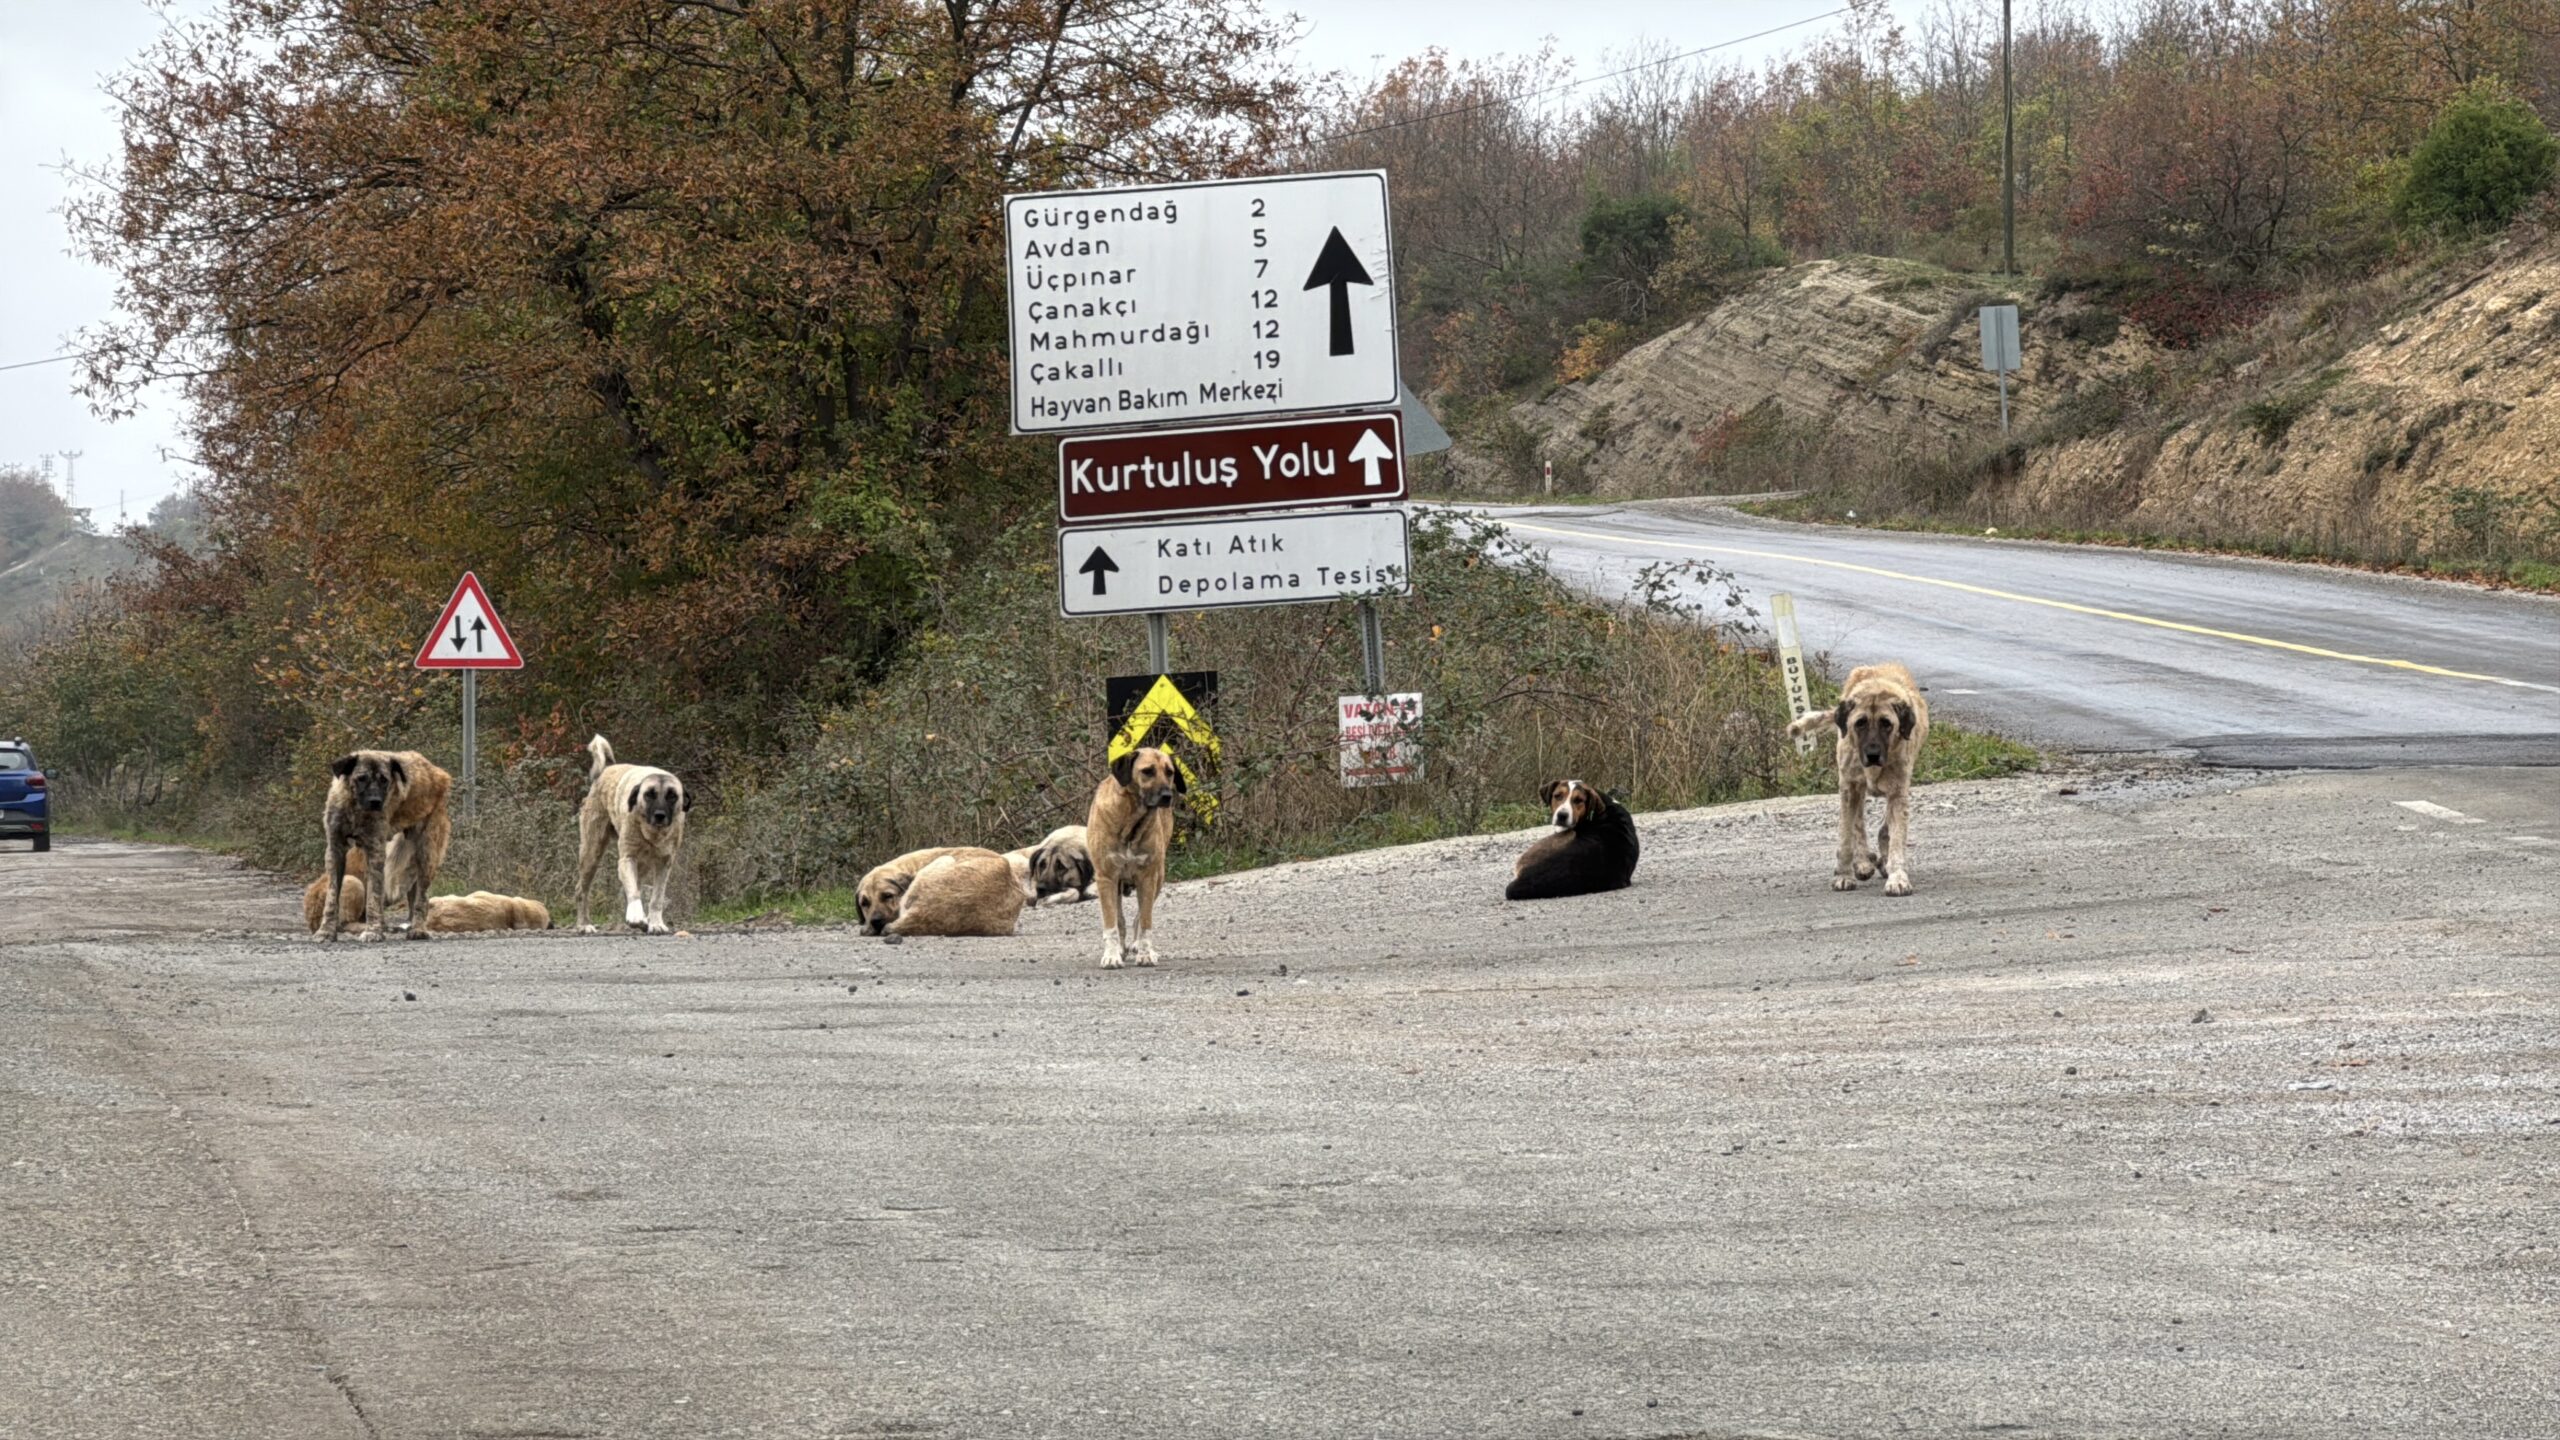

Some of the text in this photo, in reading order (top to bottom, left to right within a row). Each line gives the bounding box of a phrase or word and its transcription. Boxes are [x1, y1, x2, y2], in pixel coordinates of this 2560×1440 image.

[1024, 198, 1266, 230] Gürgendağ 2
[1024, 228, 1267, 260] Avdan 5
[1026, 258, 1269, 293] Üçpınar 7
[1028, 288, 1278, 324] Çanakçı 12
[1030, 319, 1280, 352] Mahmurdağı 12
[1030, 349, 1281, 386] Çakallı 19
[1031, 377, 1283, 422] Hayvan Bakım Merkezi
[1071, 441, 1335, 494] Kurtuluş Yolu
[1157, 533, 1284, 558] Katı Atık
[1158, 563, 1397, 598] Depolama Tesisi
